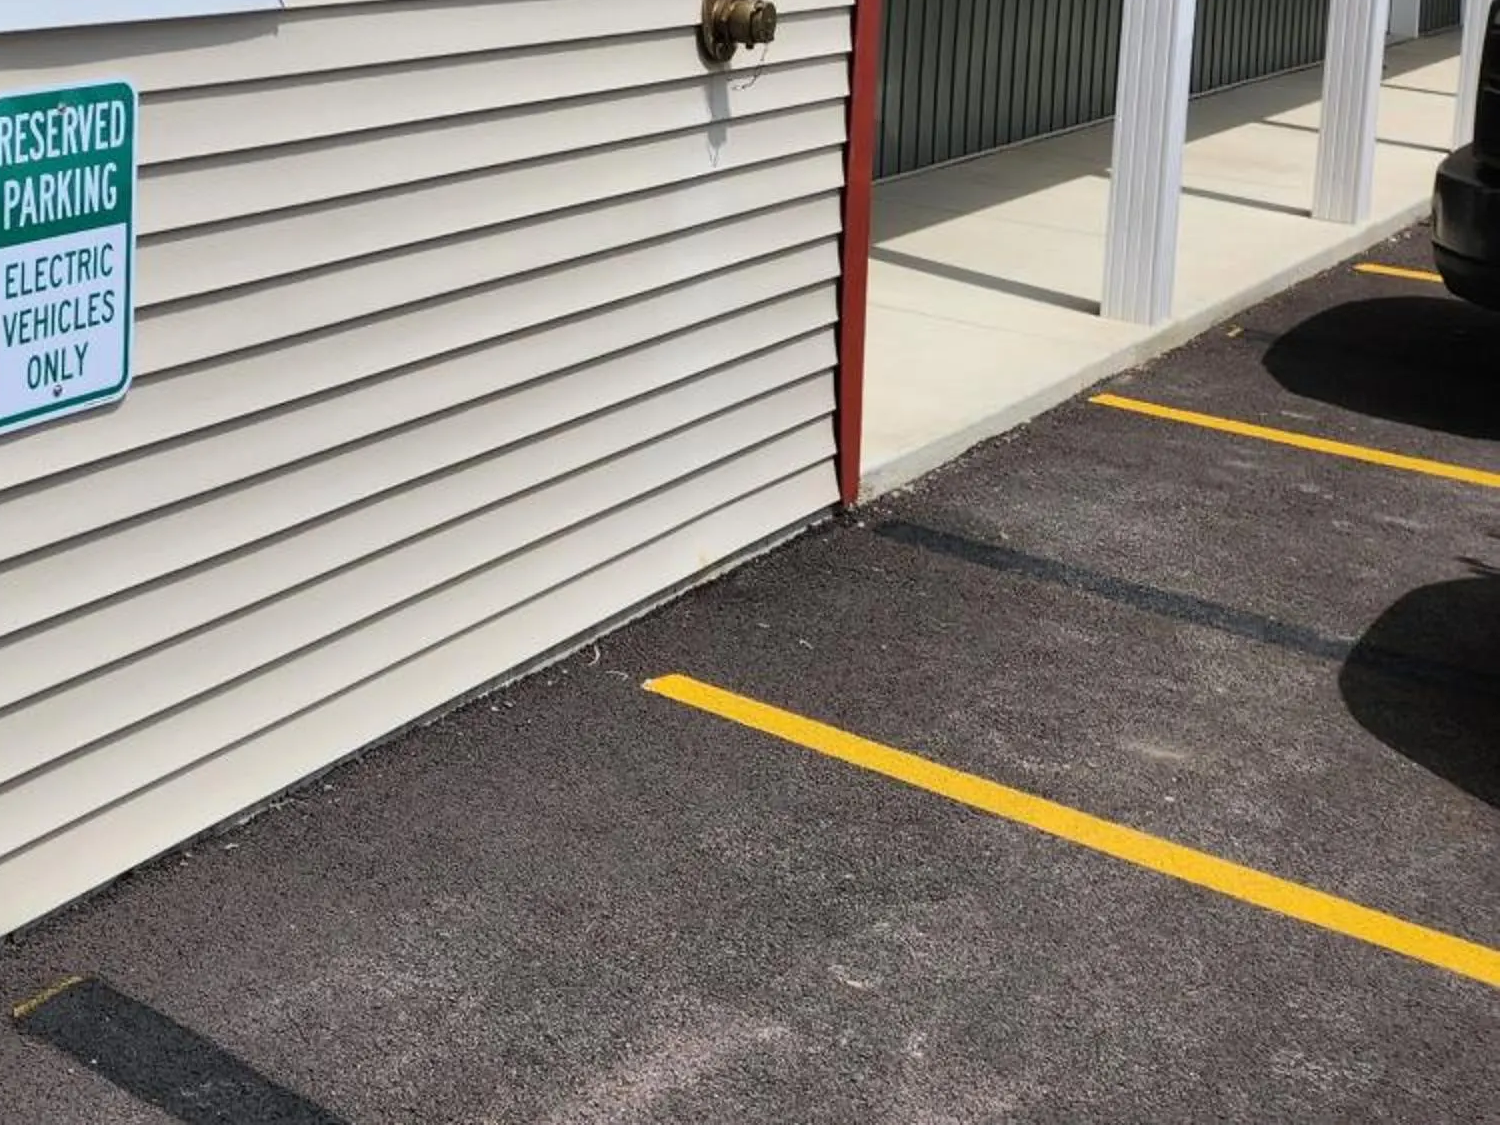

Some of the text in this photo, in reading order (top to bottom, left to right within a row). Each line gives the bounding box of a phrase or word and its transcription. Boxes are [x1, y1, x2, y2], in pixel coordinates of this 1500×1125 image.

[3, 162, 118, 230] PARKING
[4, 242, 113, 300] ELECTRIC
[2, 290, 115, 347] VEHICLES
[26, 341, 89, 390] ONLY
